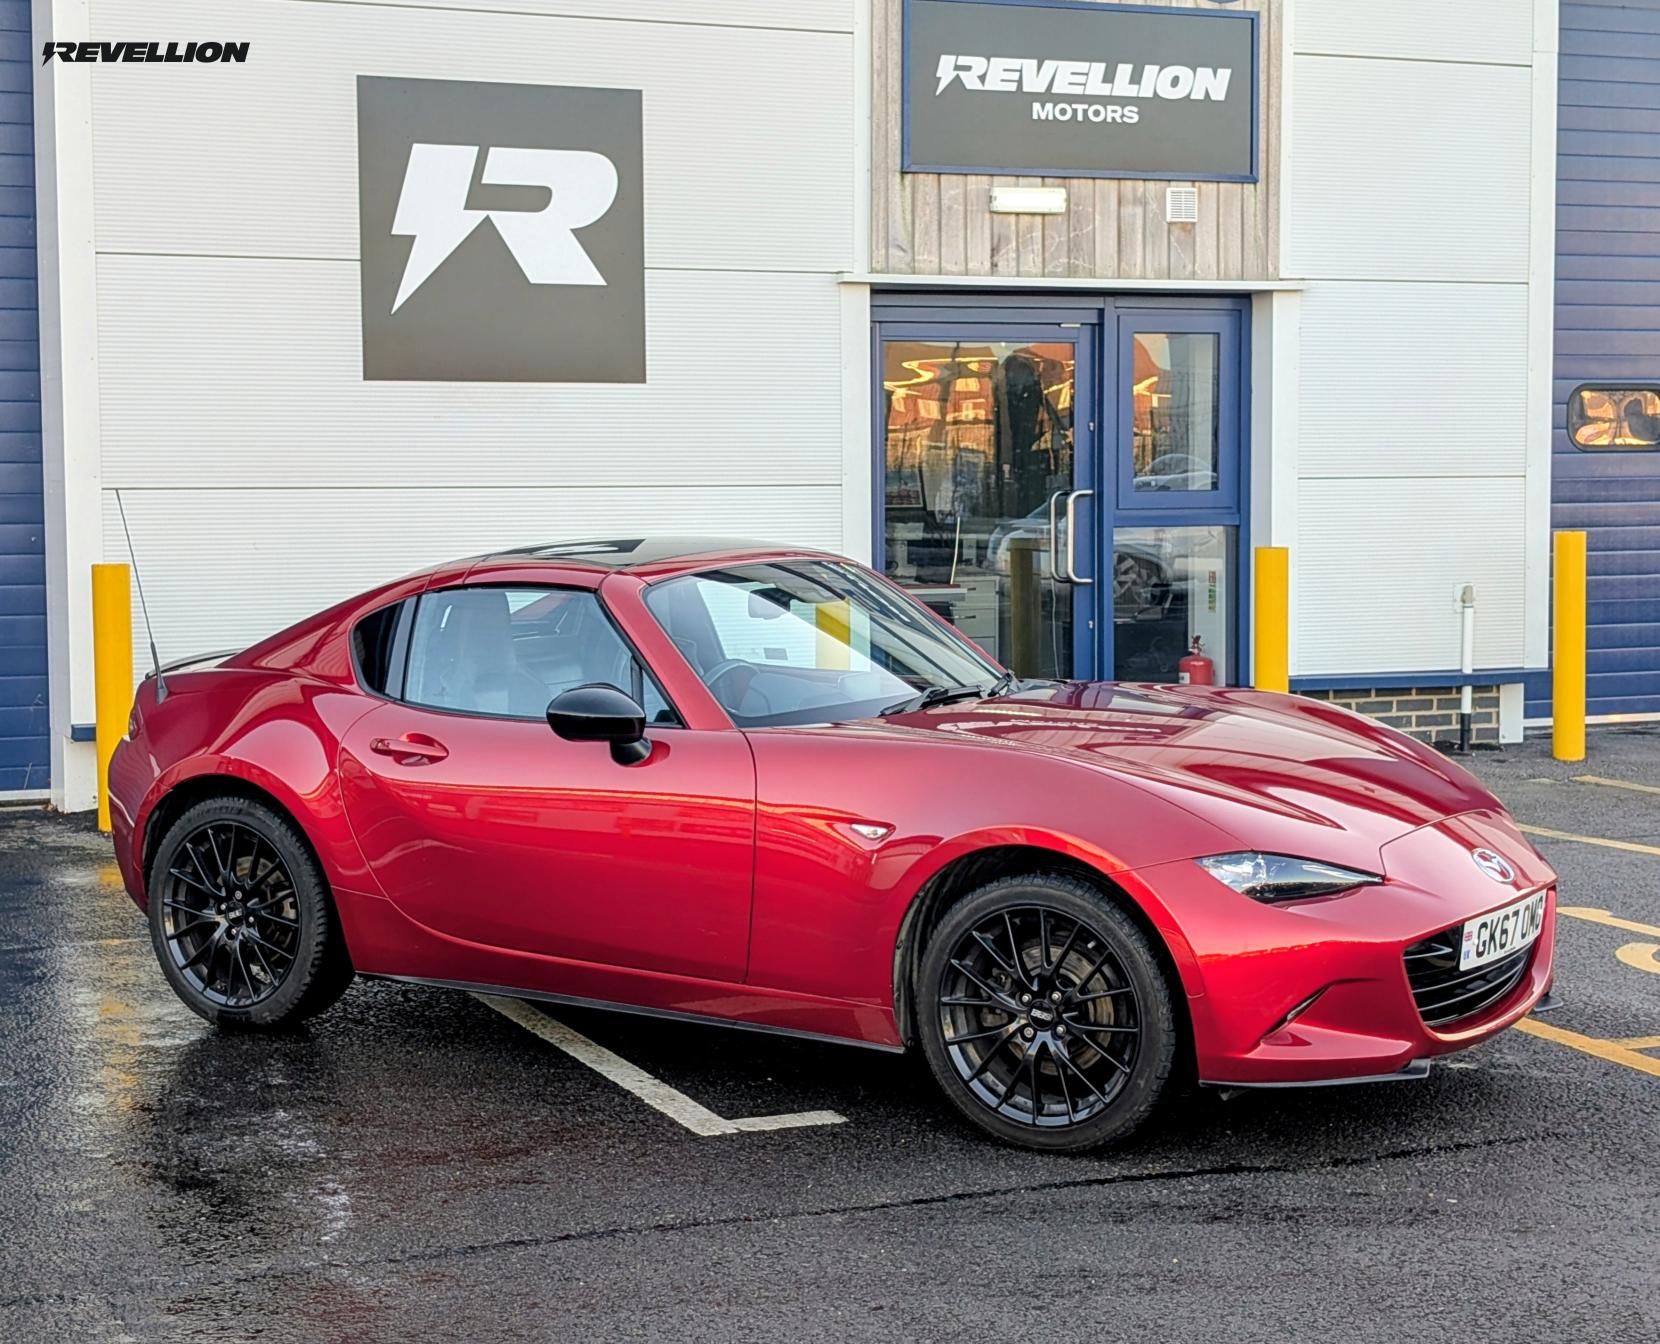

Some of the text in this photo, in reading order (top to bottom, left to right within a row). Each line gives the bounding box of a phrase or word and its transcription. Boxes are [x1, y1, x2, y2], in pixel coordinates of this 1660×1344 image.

[935, 54, 1231, 101] REVELLION
[1032, 102, 1140, 124] MOTORS
[391, 143, 619, 314] R
[1475, 908, 1520, 958] GK67
